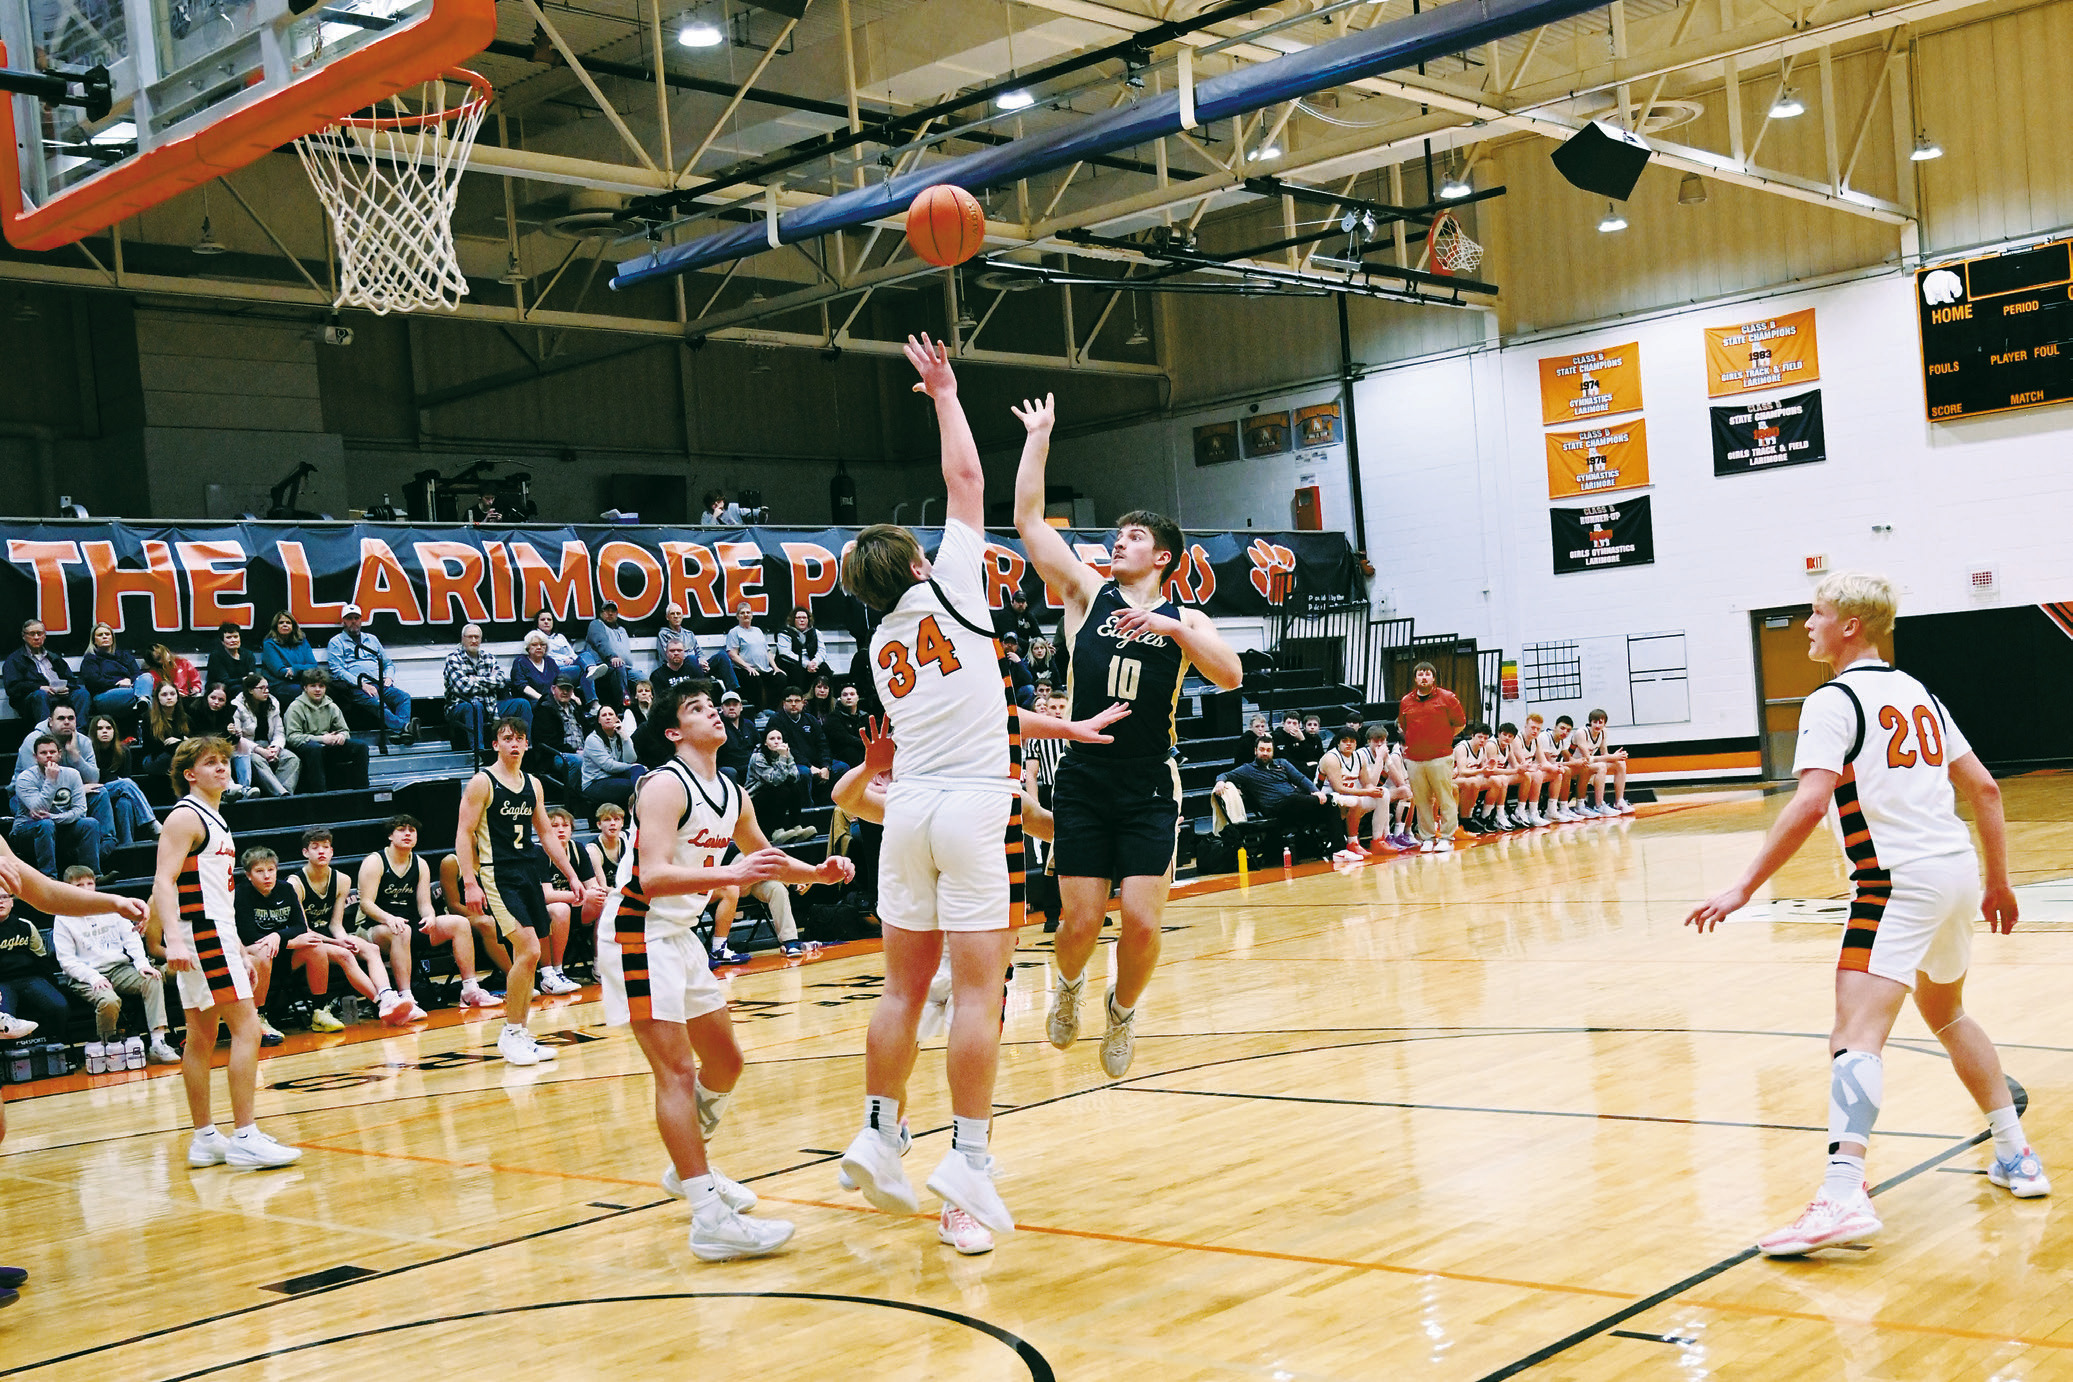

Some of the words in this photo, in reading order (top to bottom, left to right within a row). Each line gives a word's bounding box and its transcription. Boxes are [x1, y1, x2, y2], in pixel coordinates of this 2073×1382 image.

[1932, 304, 1973, 325] HOME
[2003, 300, 2040, 316] PERIOD
[1723, 336, 1746, 347] STATE
[1749, 326, 1797, 342] CHAMPIONS
[1741, 322, 1767, 334] CLASS
[1572, 354, 1596, 365] CLASS
[1749, 349, 1772, 361] 1983
[1929, 361, 1960, 376] FOULS
[1990, 350, 2028, 365] PLAYER
[2033, 343, 2060, 358] FOUL
[1556, 366, 1577, 377] STATE
[1579, 358, 1623, 373] CHAMPIONS
[1721, 371, 1743, 382] GIRLS
[1746, 367, 1770, 378] TRACK
[1782, 361, 1803, 372] FIELD
[1580, 380, 1600, 390] 1974
[1743, 374, 1782, 388] LARIMORE
[1569, 394, 1613, 408] GYMNASTICS
[1574, 403, 1609, 415] LARIMORE
[1747, 401, 1773, 413] CLASS
[1931, 403, 1963, 417] SCORE
[2010, 390, 2044, 405] MATCH
[1729, 415, 1752, 425] STATE
[1754, 406, 1803, 422] CHAMPIONS
[1562, 441, 1583, 451] STATE
[1585, 433, 1629, 448] CHAMPIONS
[1579, 429, 1602, 440] CLASS
[1727, 450, 1750, 460] GIRLS
[1752, 446, 1777, 457] TRACK
[1788, 440, 1809, 451] FIELD
[1749, 453, 1788, 466] LARIMORE
[1576, 470, 1619, 482] GYMNASTICS
[1581, 478, 1615, 490] LARIMORE
[1583, 506, 1607, 515] CLASS
[1569, 549, 1590, 559] GIRLS
[6, 539, 255, 635] THE
[276, 538, 770, 628] LARIMORE
[878, 614, 962, 698] 34
[1107, 655, 1142, 700] 10
[1879, 704, 1943, 768] 20
[500, 800, 533, 820] Eagles
[513, 824, 524, 849] 2
[0, 934, 29, 951] agles
